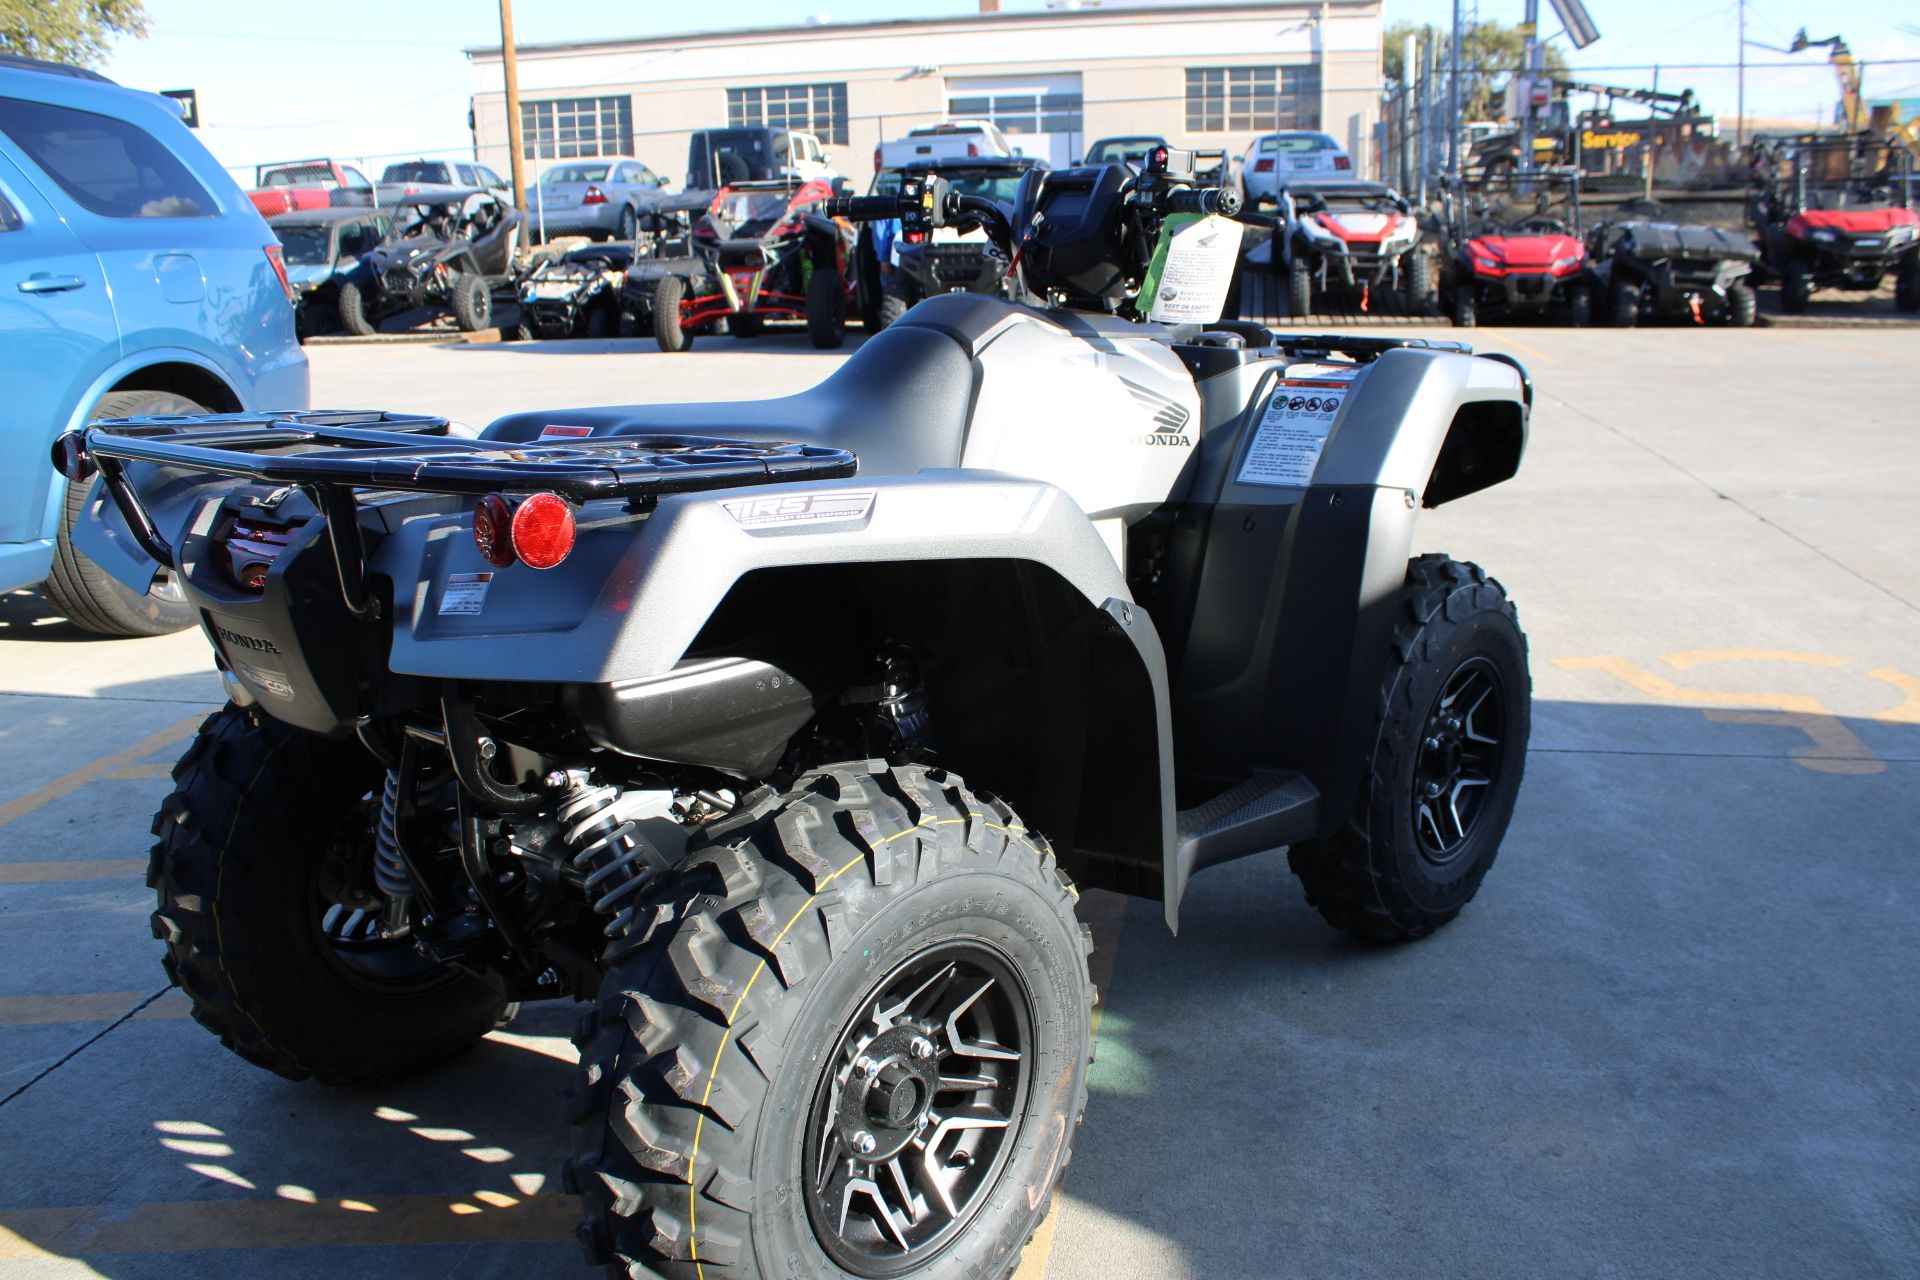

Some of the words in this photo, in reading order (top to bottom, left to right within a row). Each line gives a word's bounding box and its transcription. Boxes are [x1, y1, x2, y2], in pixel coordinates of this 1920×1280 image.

[1581, 130, 1642, 150] Service
[1129, 434, 1191, 447] HONDA
[740, 496, 808, 519] IRS
[216, 625, 281, 655] HONDA
